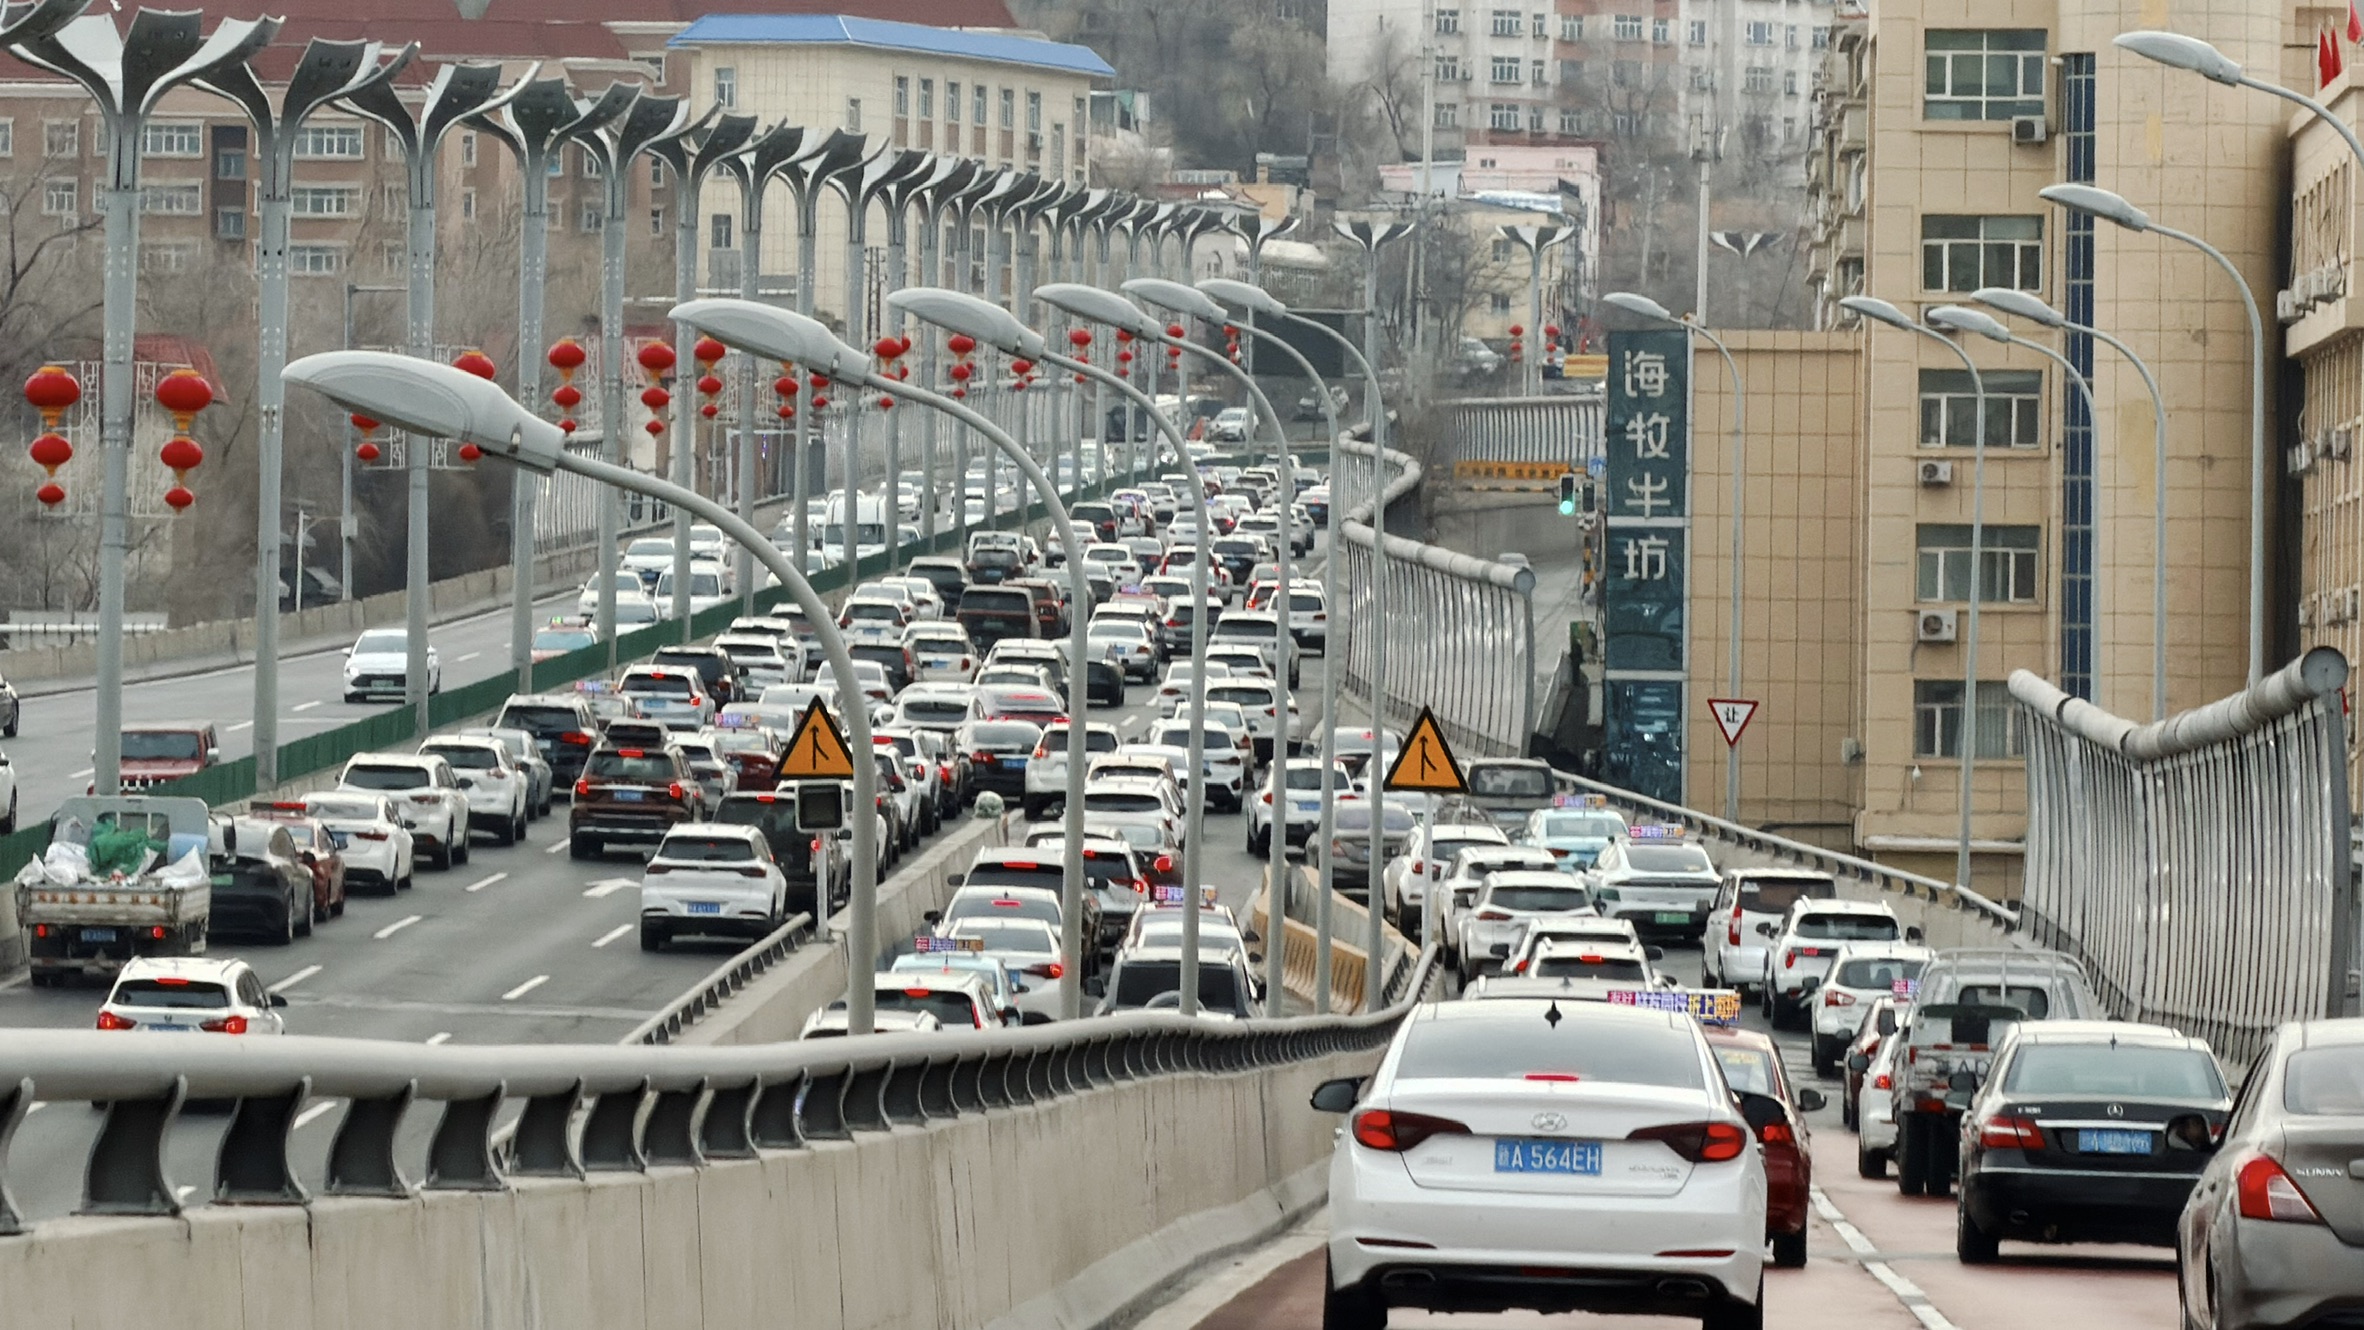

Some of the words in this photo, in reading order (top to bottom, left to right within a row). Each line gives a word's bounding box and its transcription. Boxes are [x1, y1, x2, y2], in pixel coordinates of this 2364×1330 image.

[1624, 350, 1671, 580] 海牧牛坊
[1724, 706, 1740, 723] 让
[1531, 1144, 1599, 1171] 564EH
